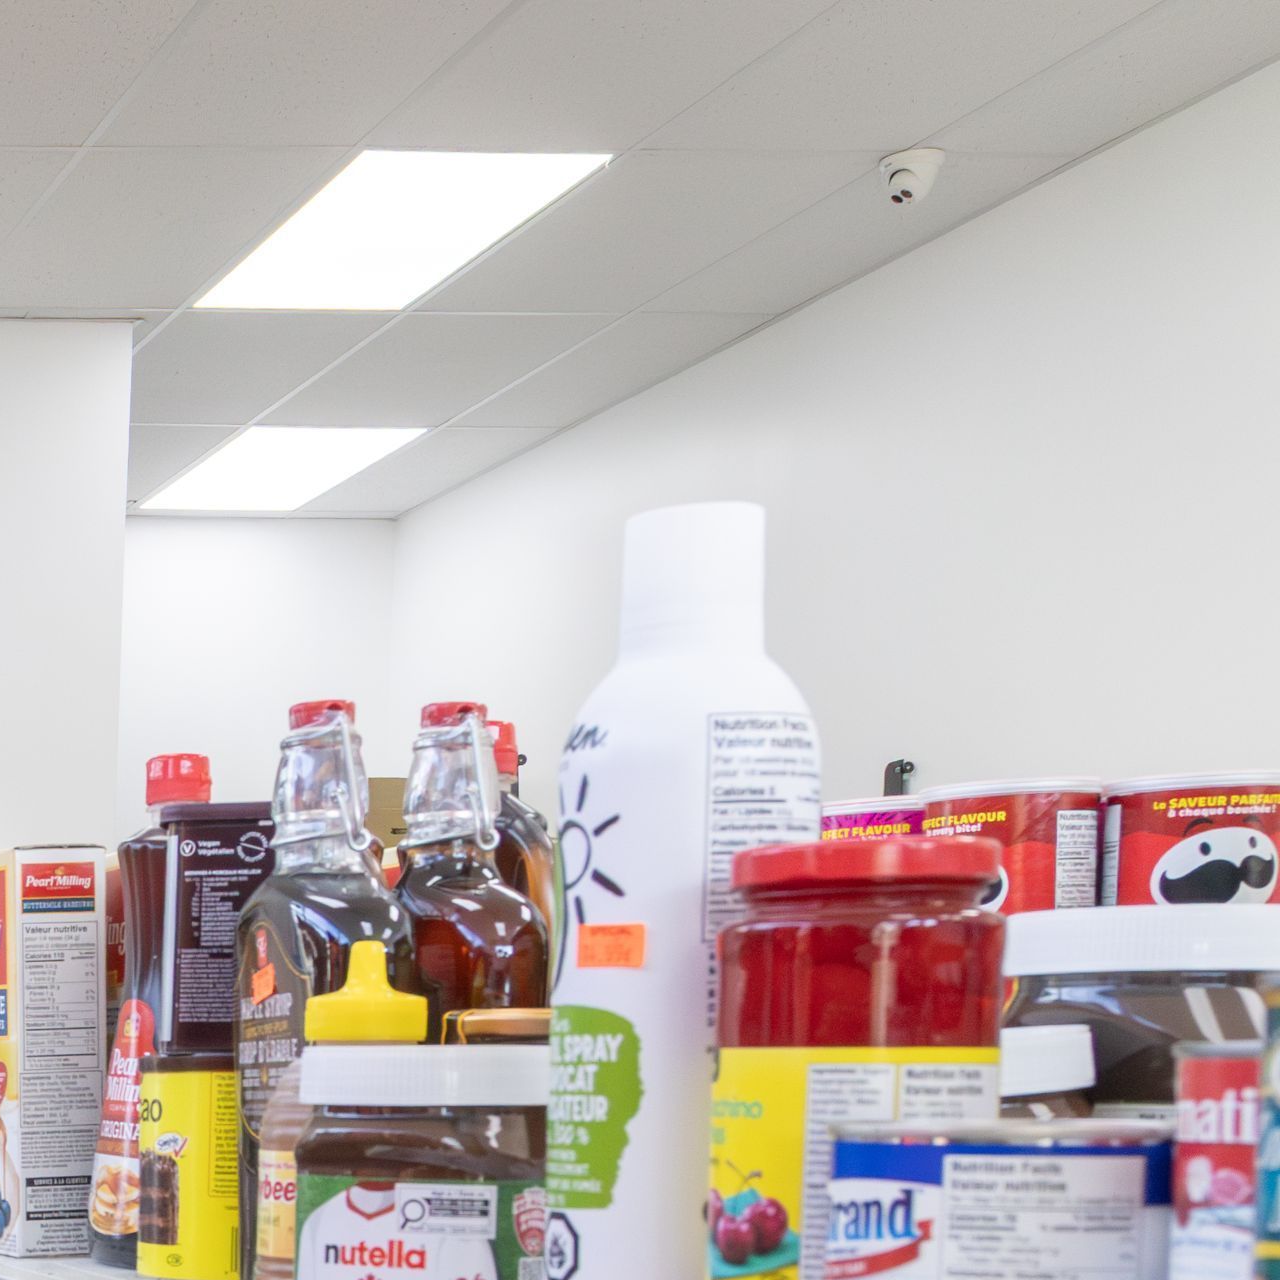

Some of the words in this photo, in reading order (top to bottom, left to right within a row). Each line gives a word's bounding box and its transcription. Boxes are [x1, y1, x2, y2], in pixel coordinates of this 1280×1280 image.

[1169, 796, 1227, 810] SAVEUR
[1231, 793, 1280, 806] PARFAIT
[957, 810, 1006, 827] FLAVOUR
[852, 822, 910, 837] FLAVOUR
[25, 874, 50, 888] Pearl
[51, 873, 91, 890] Milling
[563, 1034, 623, 1065] SPRAY
[324, 1242, 426, 1272] nutella
